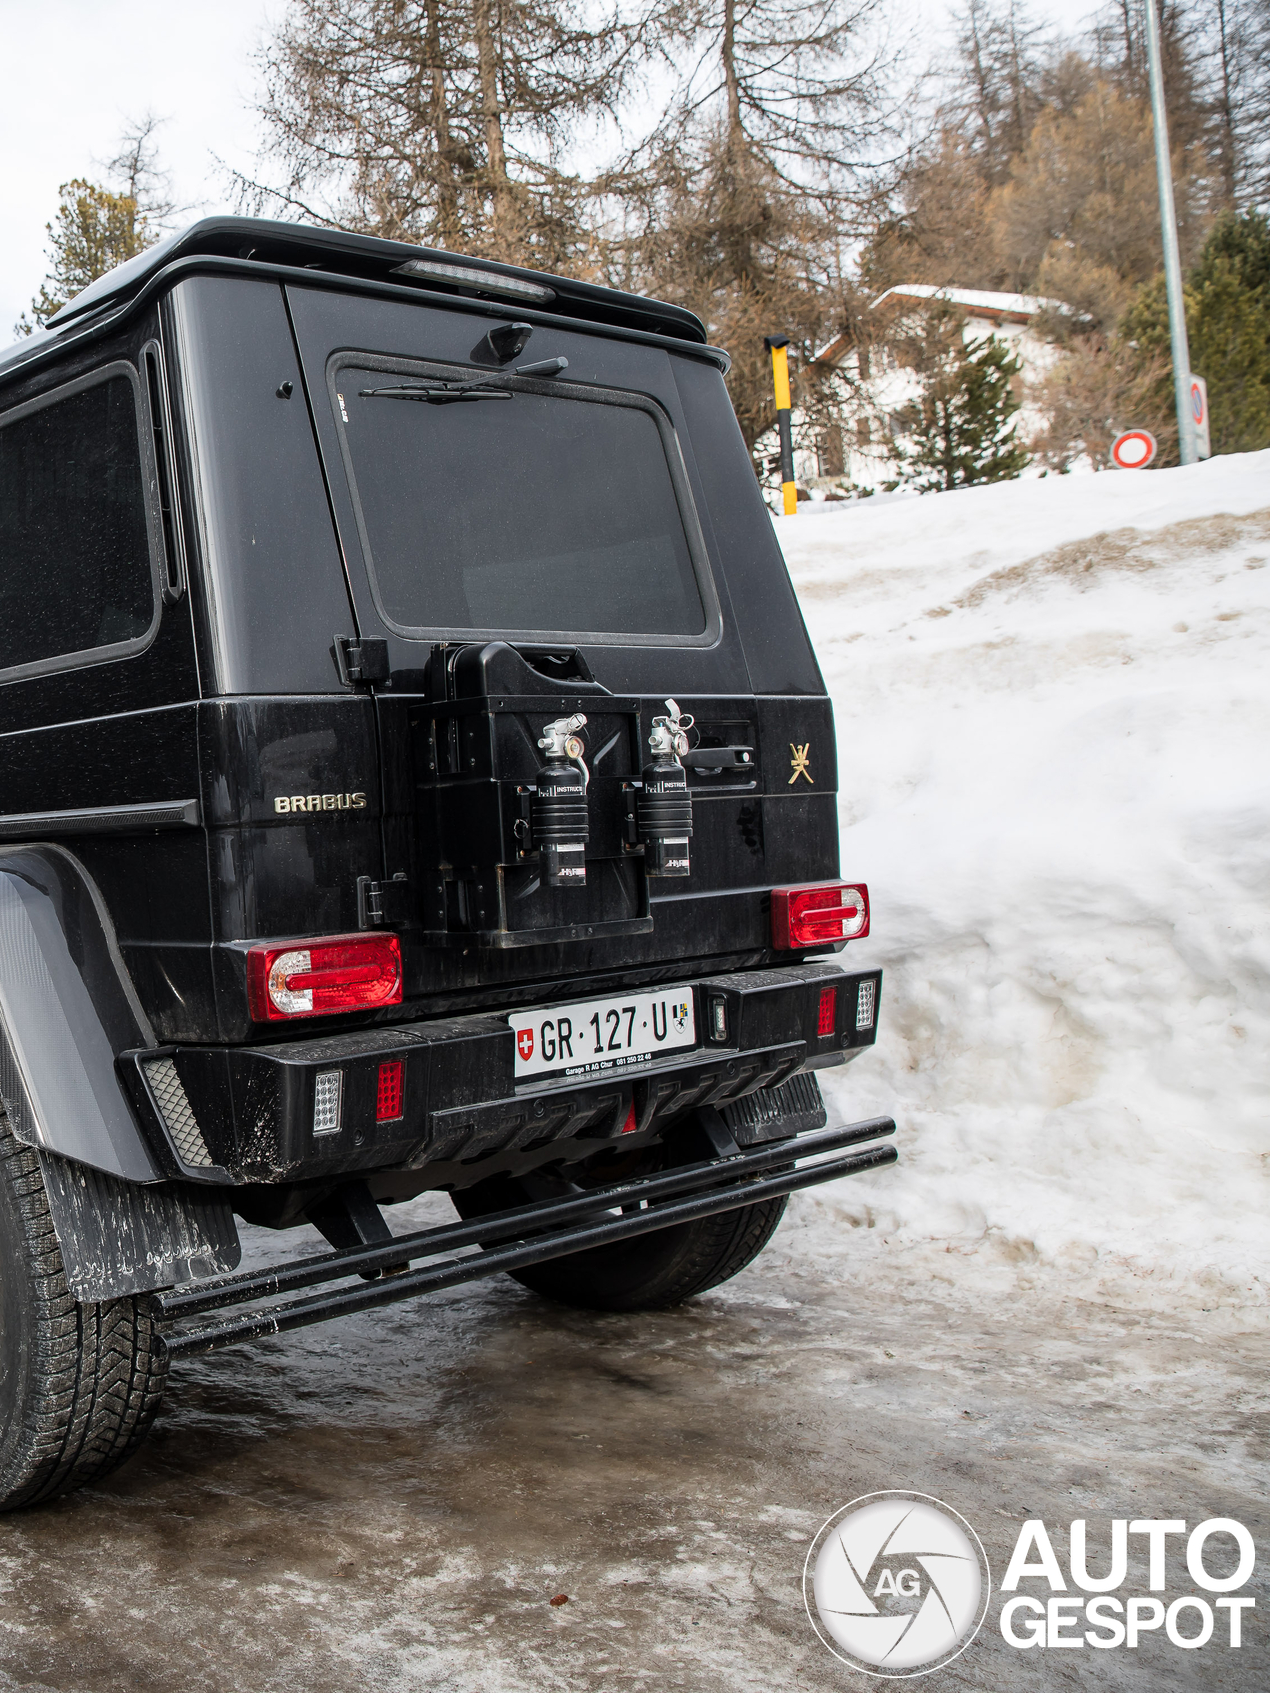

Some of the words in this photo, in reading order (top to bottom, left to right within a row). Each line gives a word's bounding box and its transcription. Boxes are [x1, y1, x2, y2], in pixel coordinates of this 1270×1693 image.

[274, 792, 367, 814] BRABUS
[565, 1066, 585, 1076] Garage
[585, 1064, 591, 1072] R
[591, 1063, 600, 1071] AG
[600, 1060, 613, 1069] Chur
[616, 1058, 627, 1066] 081
[627, 1055, 637, 1064] 250
[637, 1054, 645, 1062] 22
